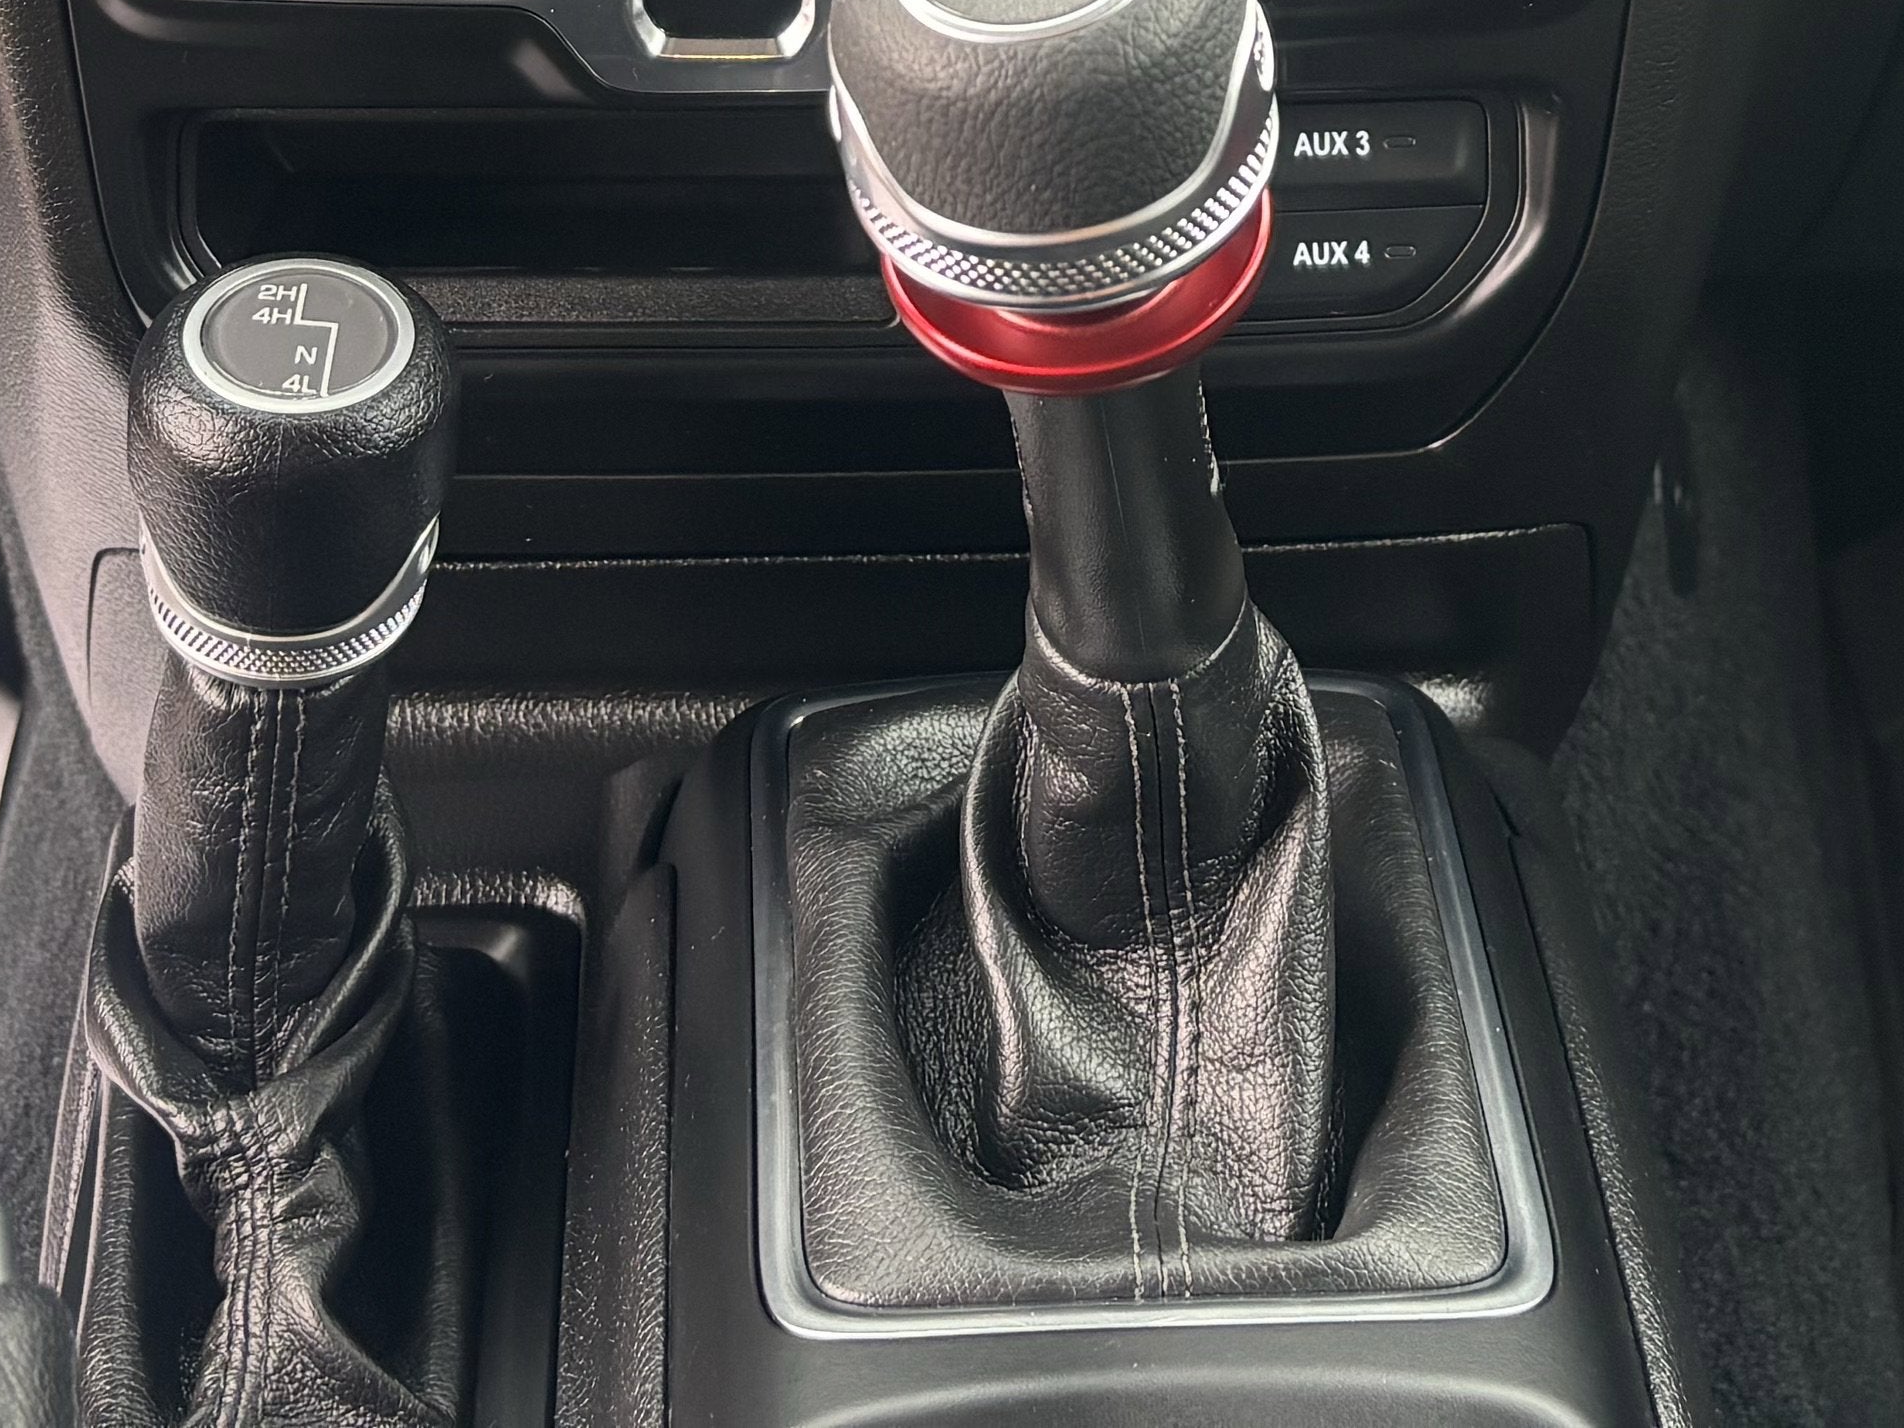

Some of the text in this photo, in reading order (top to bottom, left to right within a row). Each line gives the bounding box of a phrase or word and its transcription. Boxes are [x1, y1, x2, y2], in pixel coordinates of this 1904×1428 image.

[1294, 130, 1370, 157] AUX 3
[1293, 241, 1370, 267] AUX 4
[257, 283, 297, 302] 2H
[251, 307, 292, 325] 4H
[294, 345, 318, 365] N
[281, 374, 317, 395] 4L
